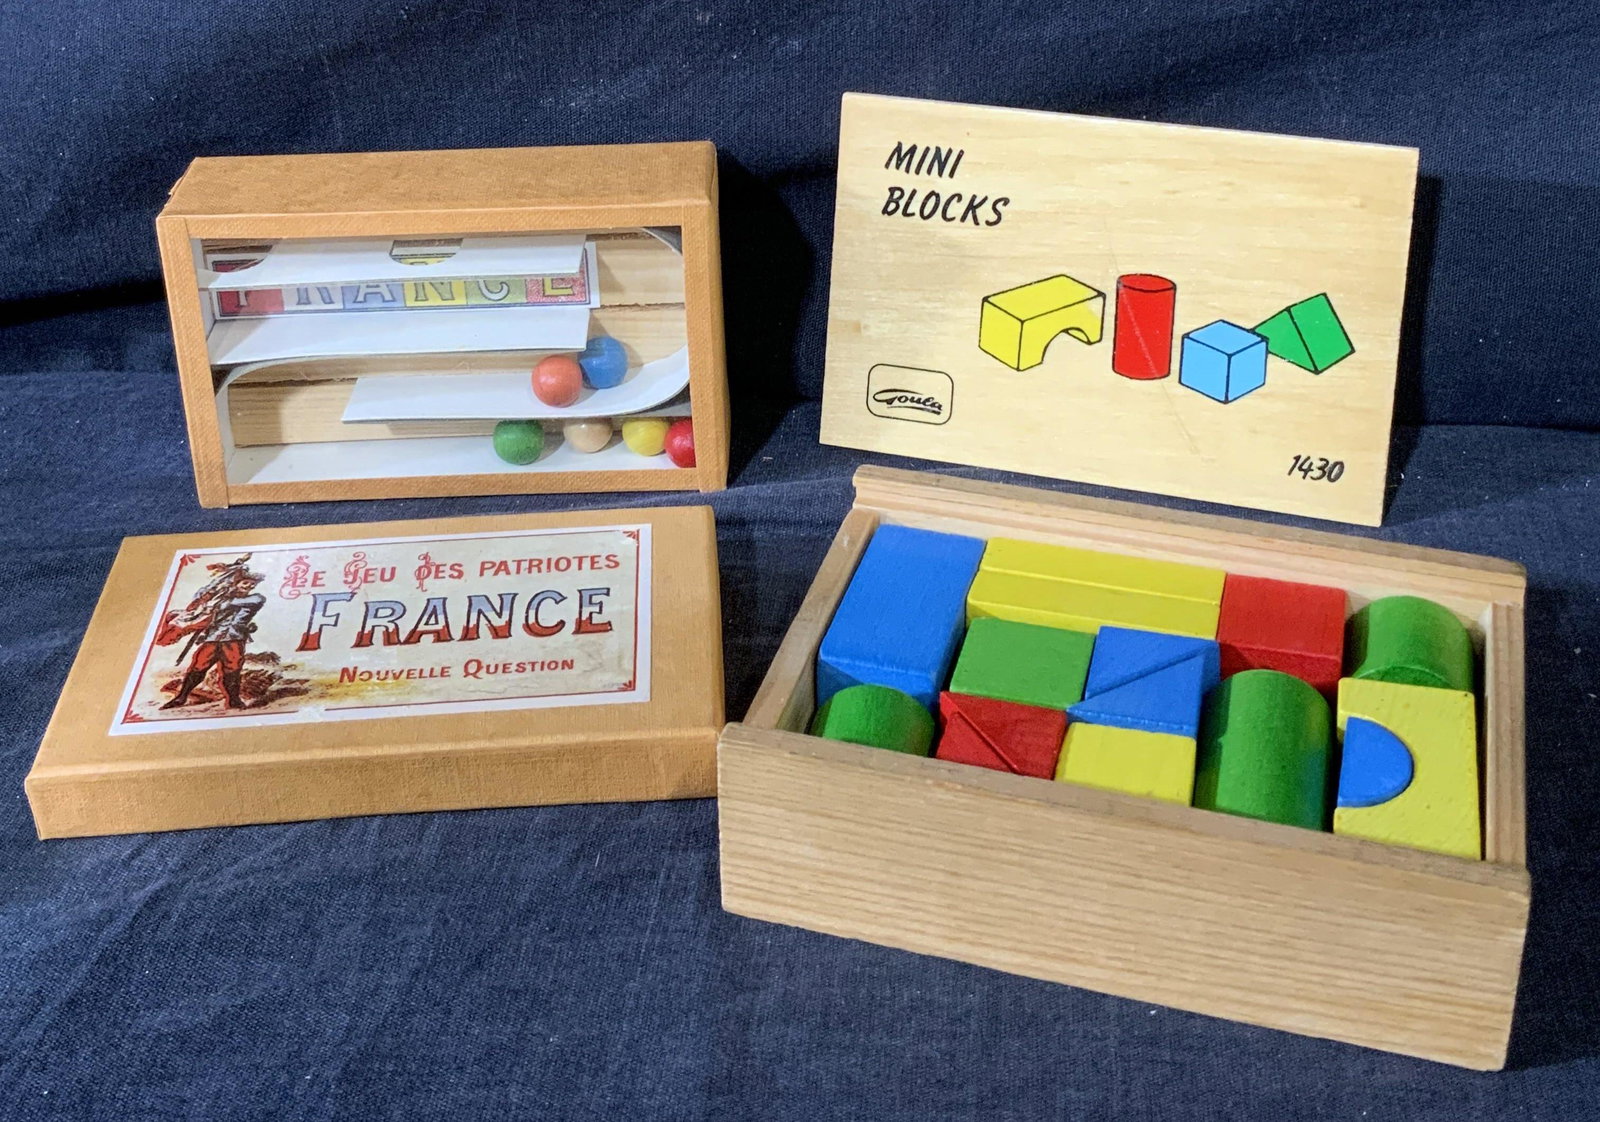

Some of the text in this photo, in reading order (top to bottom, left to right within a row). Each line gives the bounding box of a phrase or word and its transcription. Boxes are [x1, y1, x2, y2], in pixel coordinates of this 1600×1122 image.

[885, 141, 964, 179] MINI
[882, 186, 1010, 227] BLOCKS
[1287, 454, 1345, 483] 1430
[343, 551, 396, 594] JEU
[414, 552, 464, 592] DES
[479, 553, 620, 581] PATRIOTES
[295, 586, 613, 652] FRANCE
[463, 658, 575, 679] QUESTION
